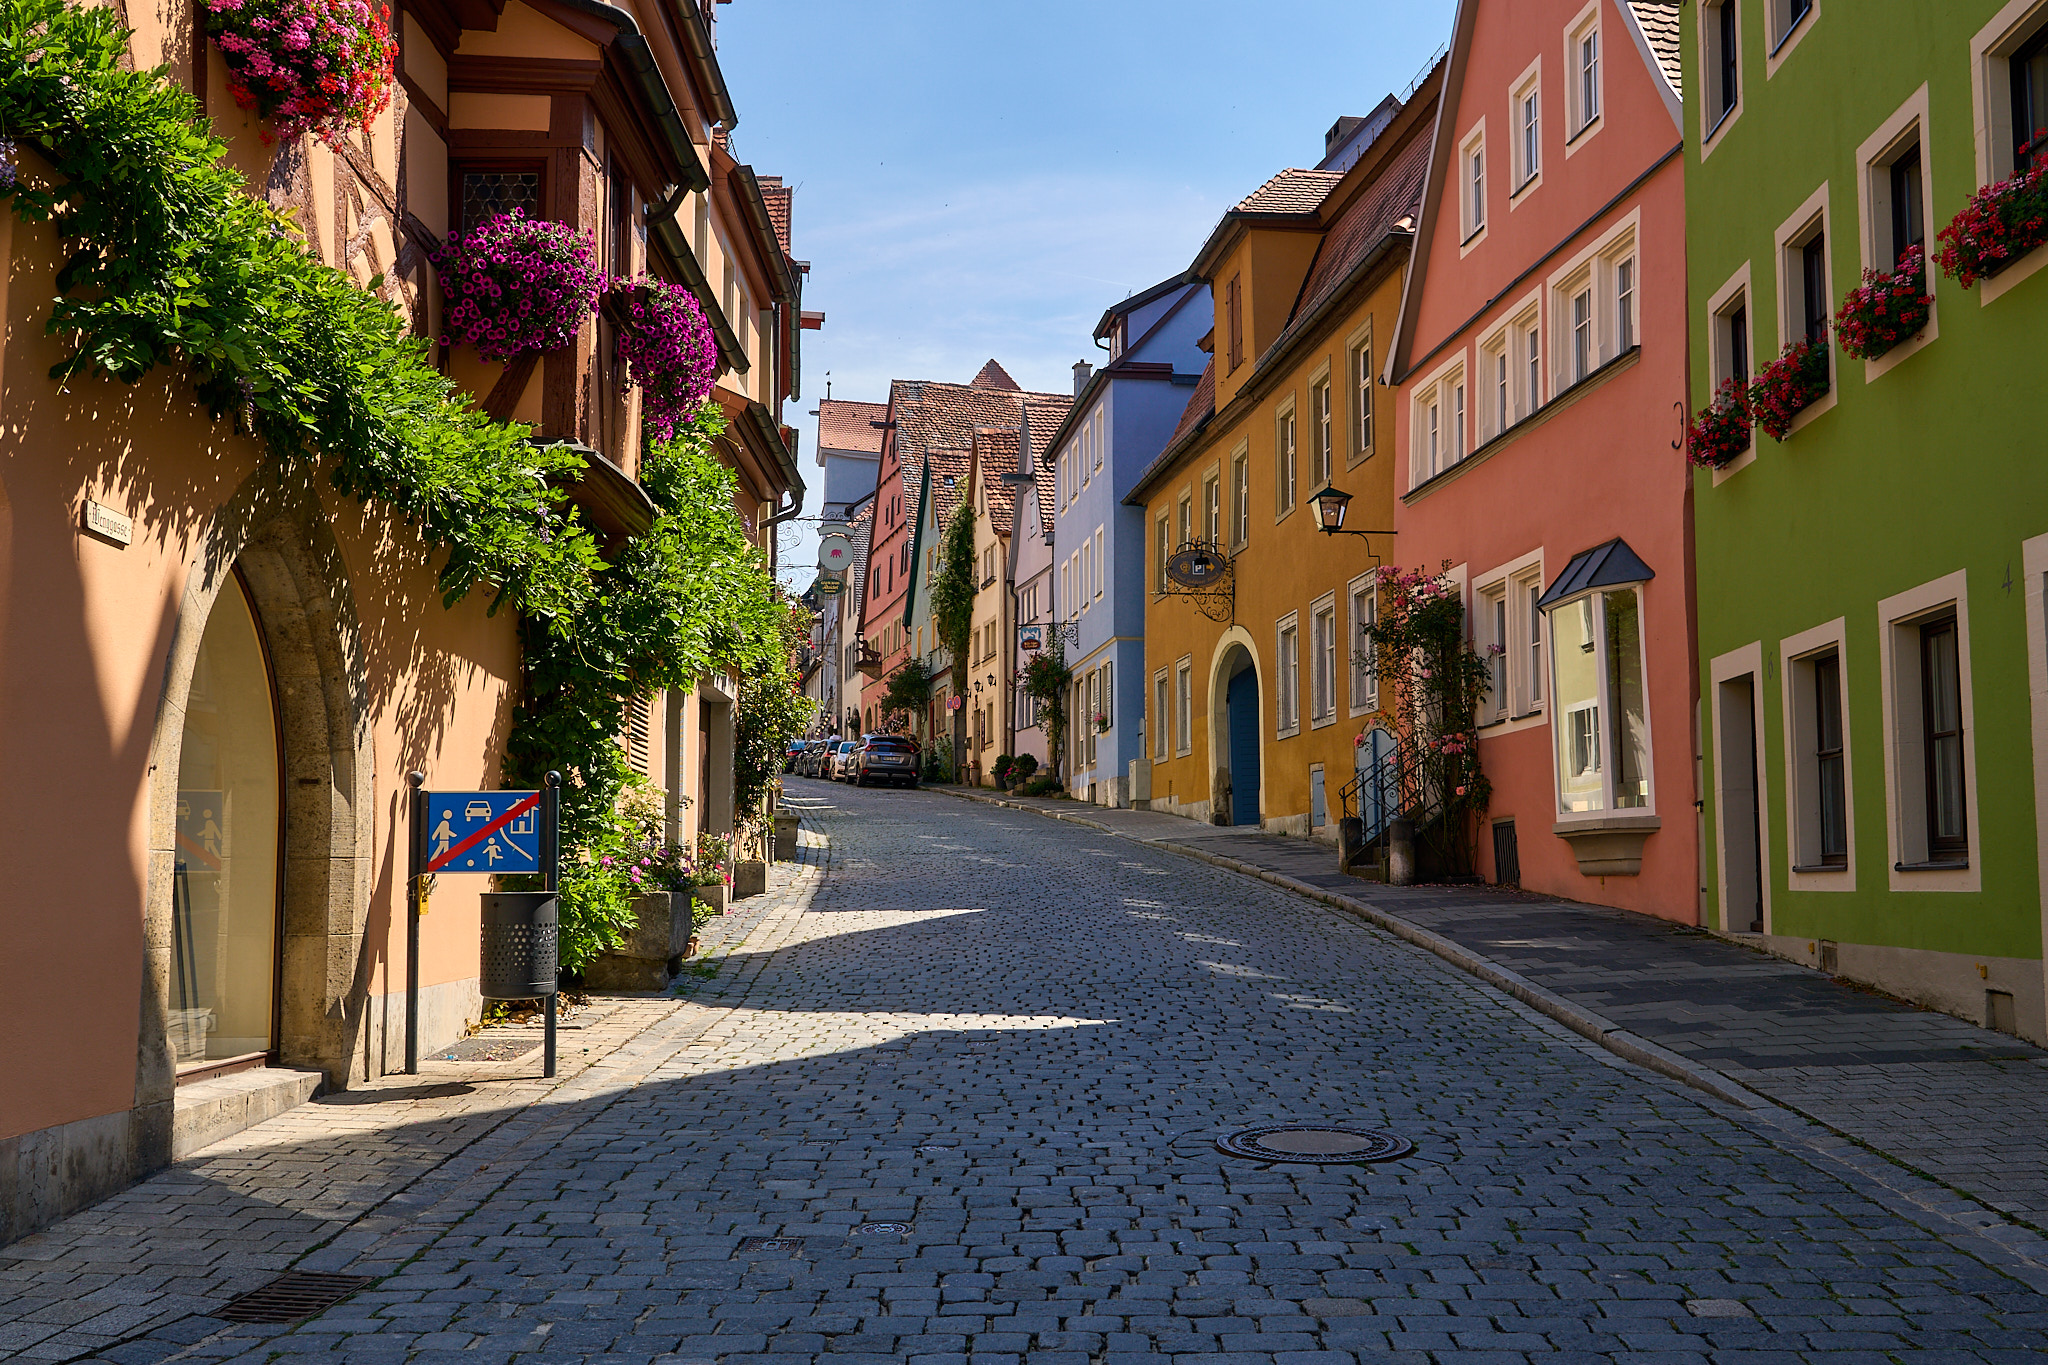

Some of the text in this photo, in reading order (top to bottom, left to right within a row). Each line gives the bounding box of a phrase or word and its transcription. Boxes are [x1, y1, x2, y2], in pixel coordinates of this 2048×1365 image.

[1195, 564, 1202, 572] P
[2001, 560, 2013, 597] 4
[1768, 651, 1774, 680] 6
